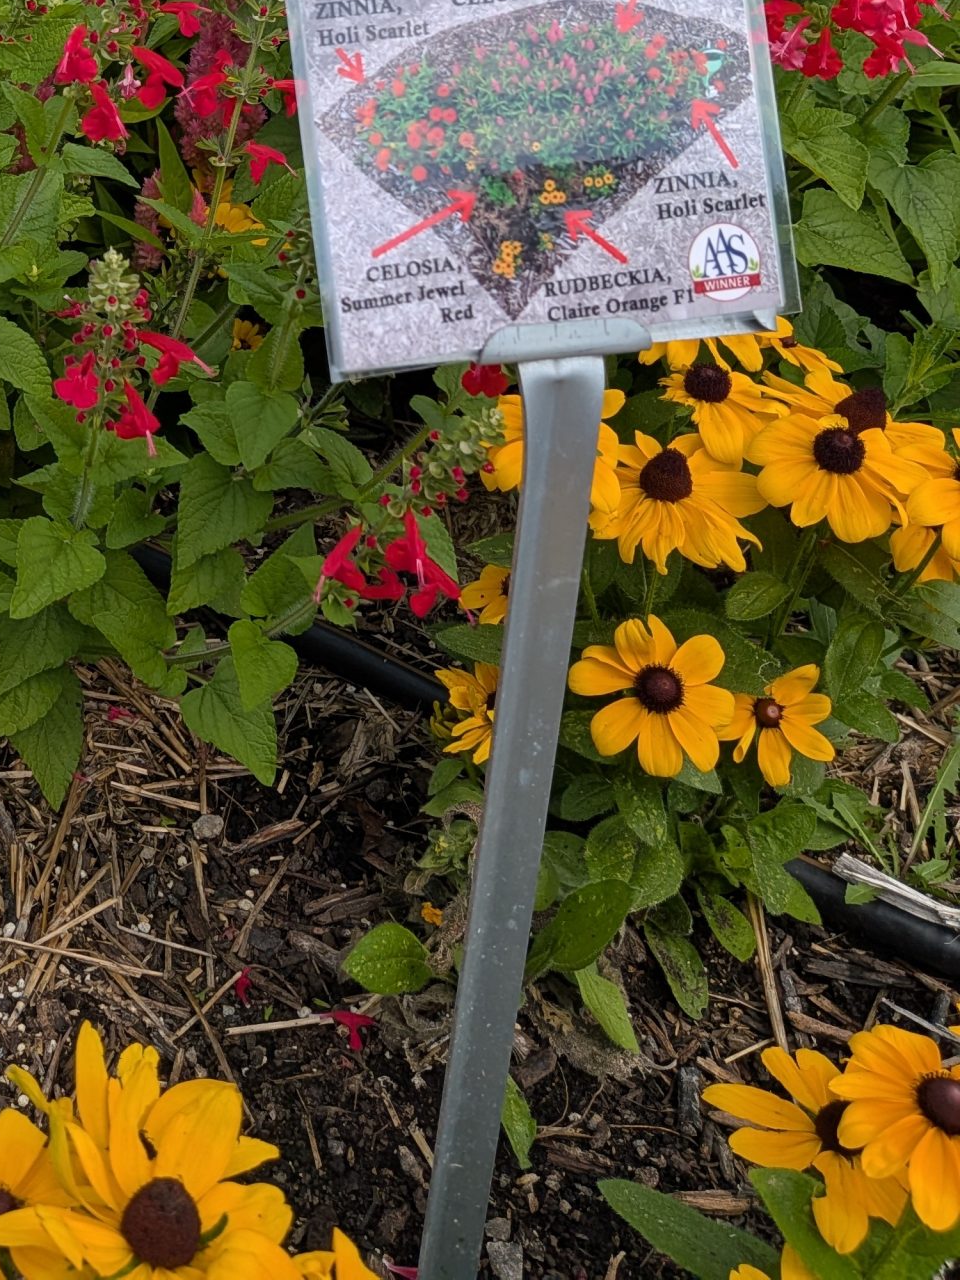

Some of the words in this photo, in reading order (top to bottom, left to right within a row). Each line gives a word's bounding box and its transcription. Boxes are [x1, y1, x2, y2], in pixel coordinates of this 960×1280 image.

[318, 27, 359, 47] Holi
[365, 21, 429, 42] Scarlet
[654, 171, 738, 194] ZINNIA,
[657, 200, 697, 221] Holi
[702, 193, 766, 215] Scarlet
[701, 227, 749, 279] AAS
[366, 257, 462, 283] CELOSIA,
[704, 275, 751, 291] WINNER
[341, 289, 412, 313] Summer
[417, 281, 465, 303] Jewel
[544, 272, 671, 298] RUDBECKIA,
[441, 304, 474, 323] Red
[547, 300, 605, 322] Claire
[610, 293, 669, 320] Orange
